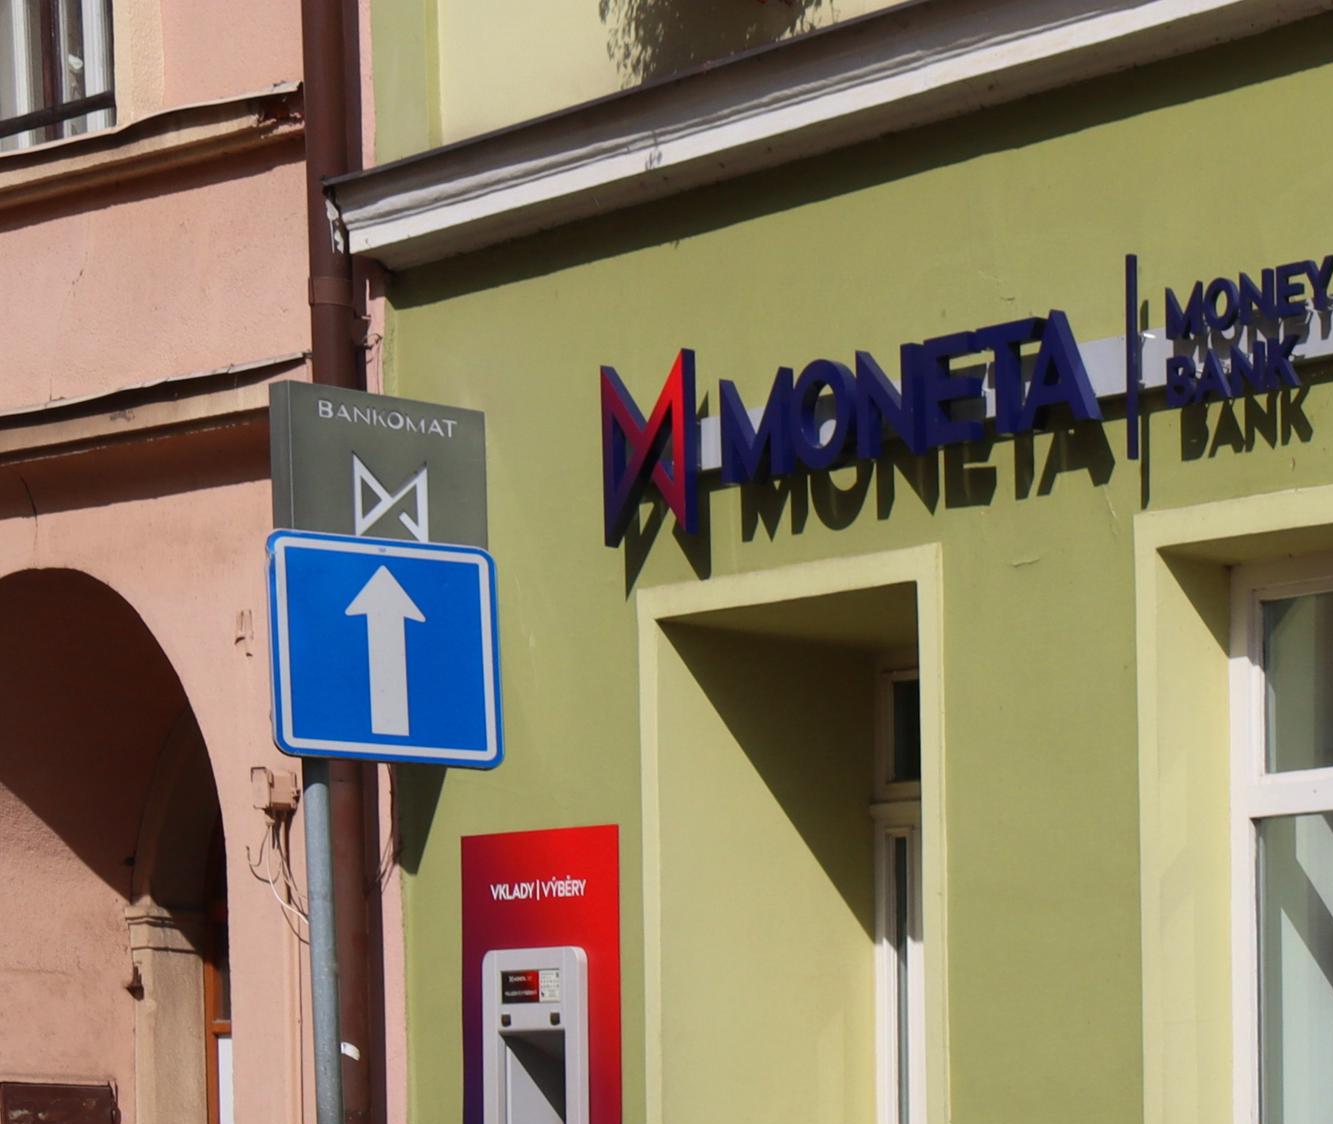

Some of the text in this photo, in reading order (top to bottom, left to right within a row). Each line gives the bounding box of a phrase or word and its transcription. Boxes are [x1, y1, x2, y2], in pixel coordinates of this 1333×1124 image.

[718, 309, 1103, 485] MONETA
[1166, 334, 1301, 408] BANK
[318, 400, 457, 438] BANKOMAT
[490, 883, 535, 900] VKLADY
